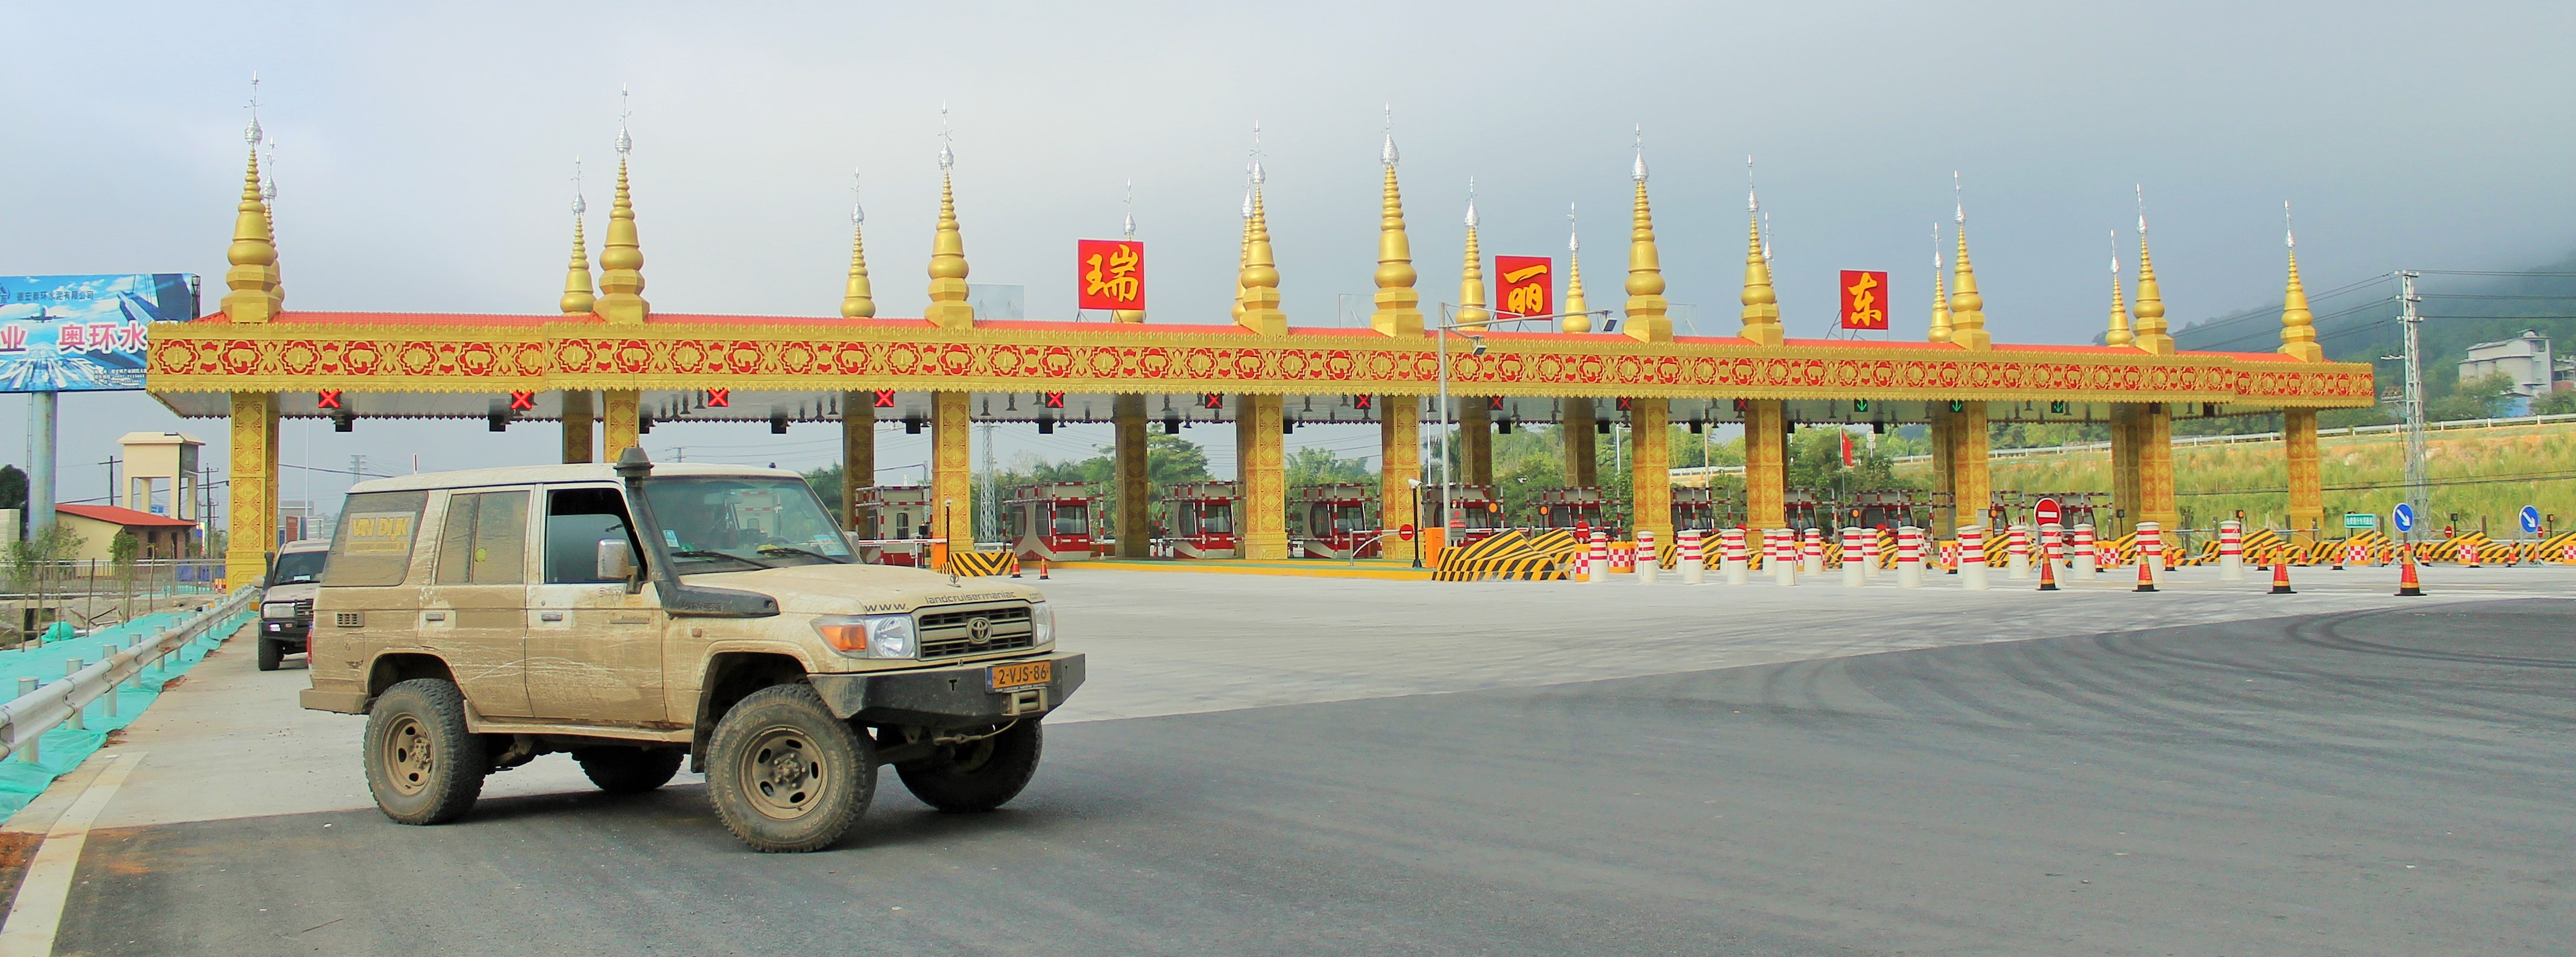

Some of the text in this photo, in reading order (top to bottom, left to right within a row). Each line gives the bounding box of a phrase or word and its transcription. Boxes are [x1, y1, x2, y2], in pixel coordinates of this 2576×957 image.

[1086, 244, 1882, 326] 瑞 丽 东
[0, 324, 147, 352] 业 奥环水
[352, 517, 376, 537] VAN
[924, 591, 1017, 604] landcruisermaniac
[998, 665, 1047, 685] 2-VJS-86
